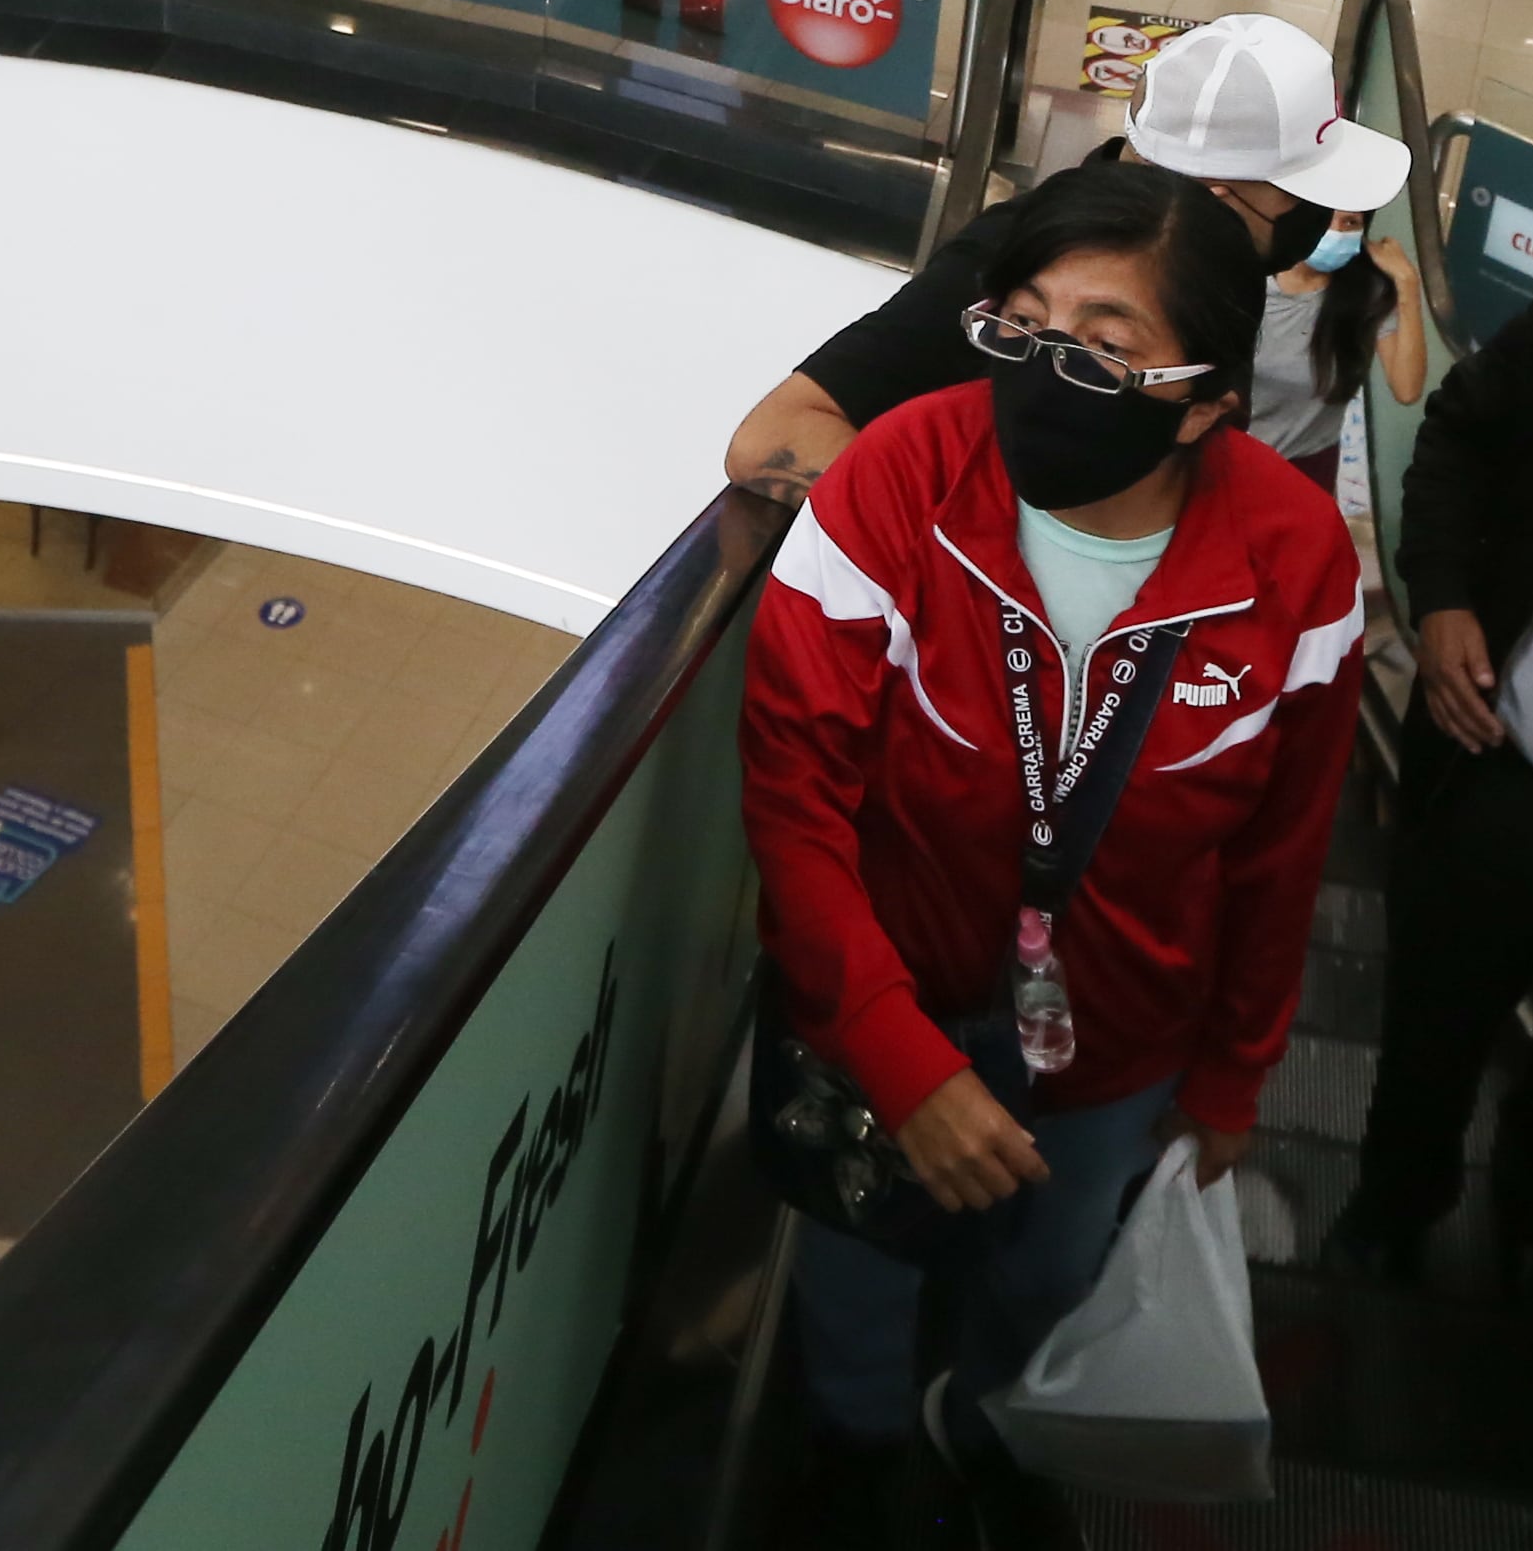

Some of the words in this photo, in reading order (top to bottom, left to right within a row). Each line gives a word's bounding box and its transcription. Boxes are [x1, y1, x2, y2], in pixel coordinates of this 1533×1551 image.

[1012, 682, 1035, 749] CREMA
[1078, 692, 1121, 752] GARRA
[1172, 681, 1229, 708] PUMA
[1022, 751, 1046, 813] GARRA
